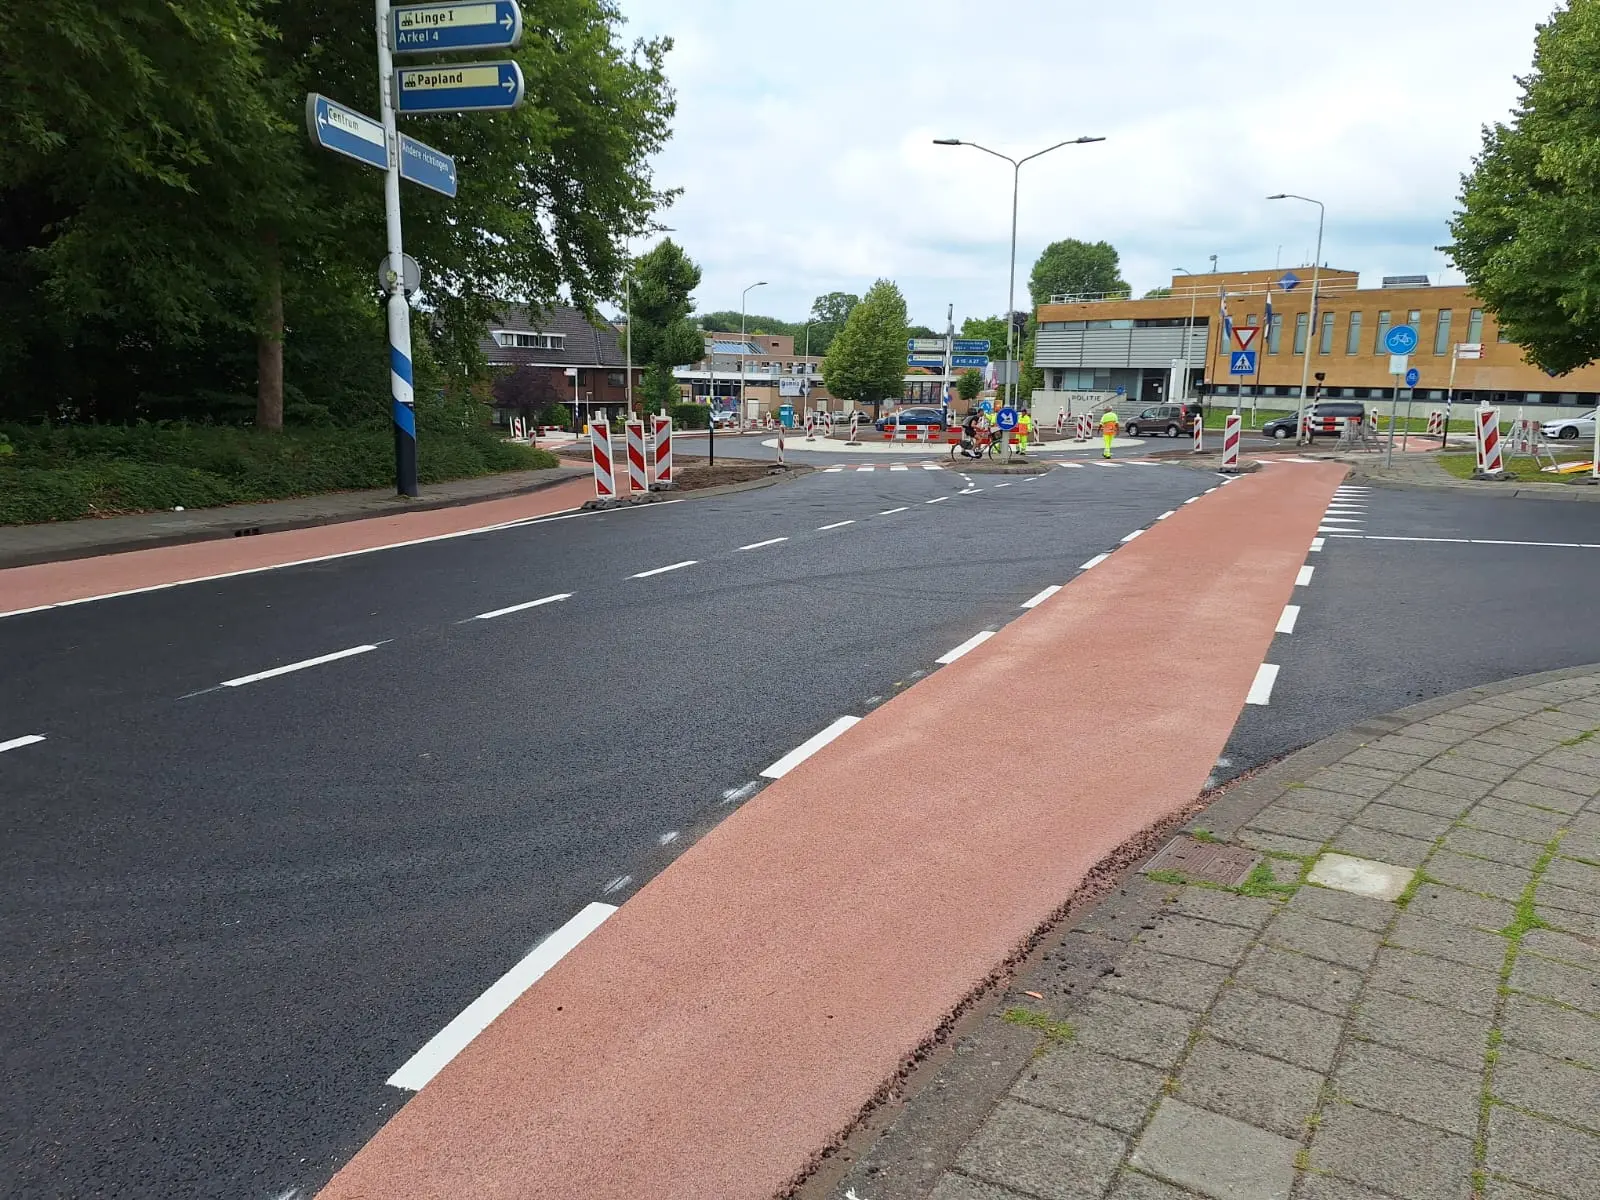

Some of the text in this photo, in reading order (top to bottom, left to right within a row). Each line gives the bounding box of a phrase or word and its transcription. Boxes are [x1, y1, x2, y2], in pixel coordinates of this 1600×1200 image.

[415, 11, 446, 25] Linge
[399, 30, 439, 43] Arkel 4
[417, 72, 463, 87] Papland
[328, 108, 359, 131] Centrum
[402, 141, 449, 172] Andere richtingen
[1071, 394, 1102, 402] POLITIE
